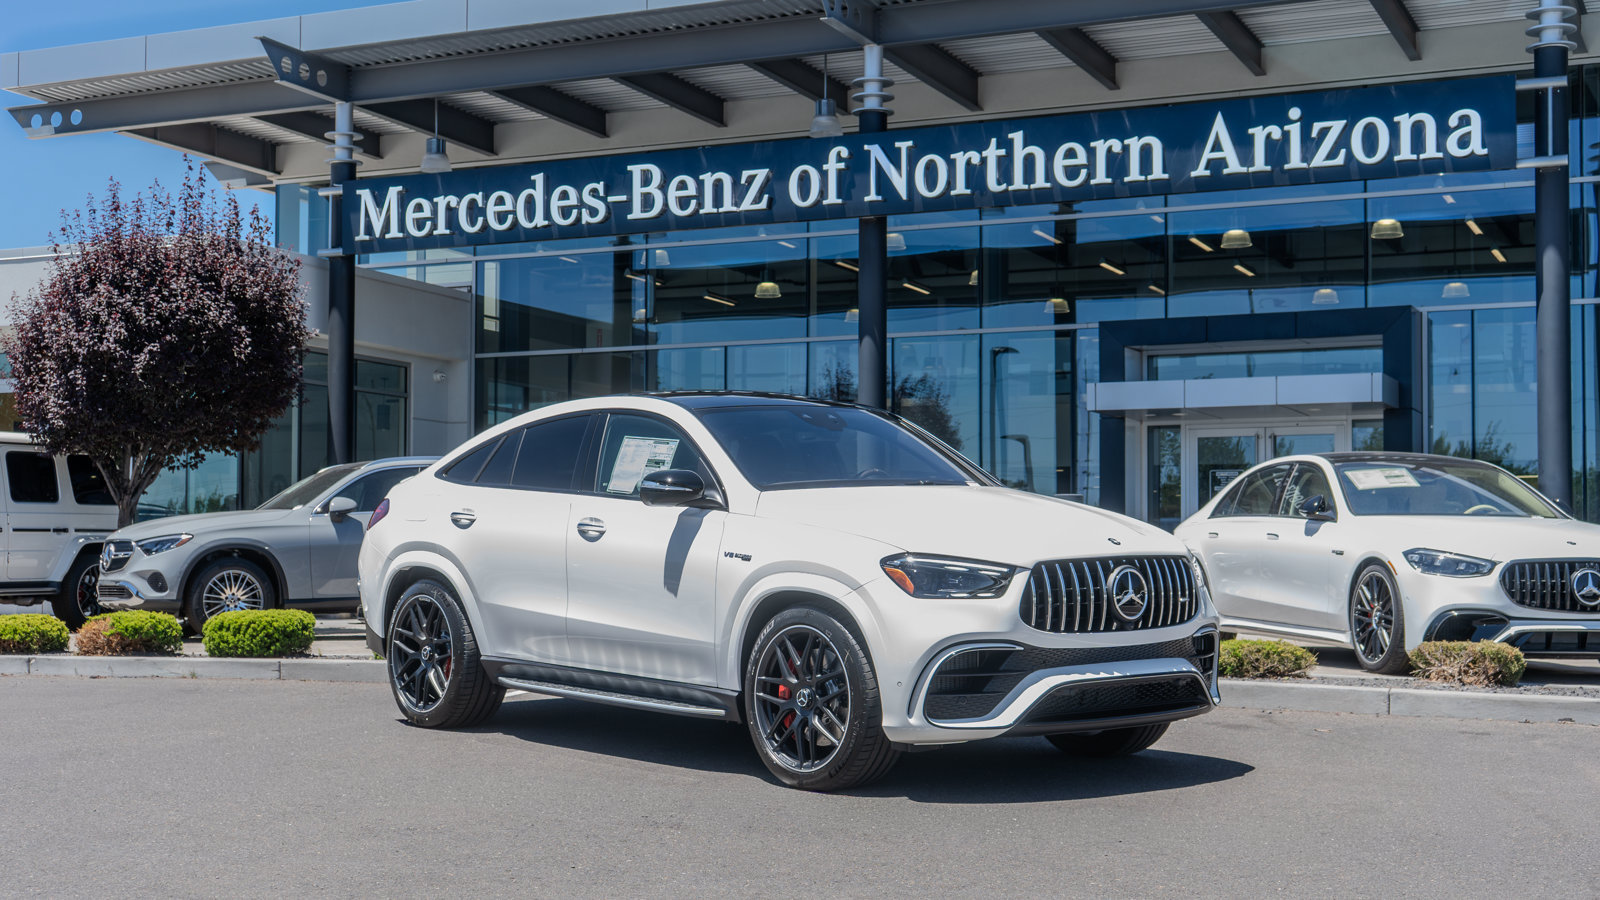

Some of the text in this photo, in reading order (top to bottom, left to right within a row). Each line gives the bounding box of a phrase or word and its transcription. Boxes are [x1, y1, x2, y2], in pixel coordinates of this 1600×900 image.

[354, 108, 1489, 241] Mercedes-Benz of Northern Arizona
